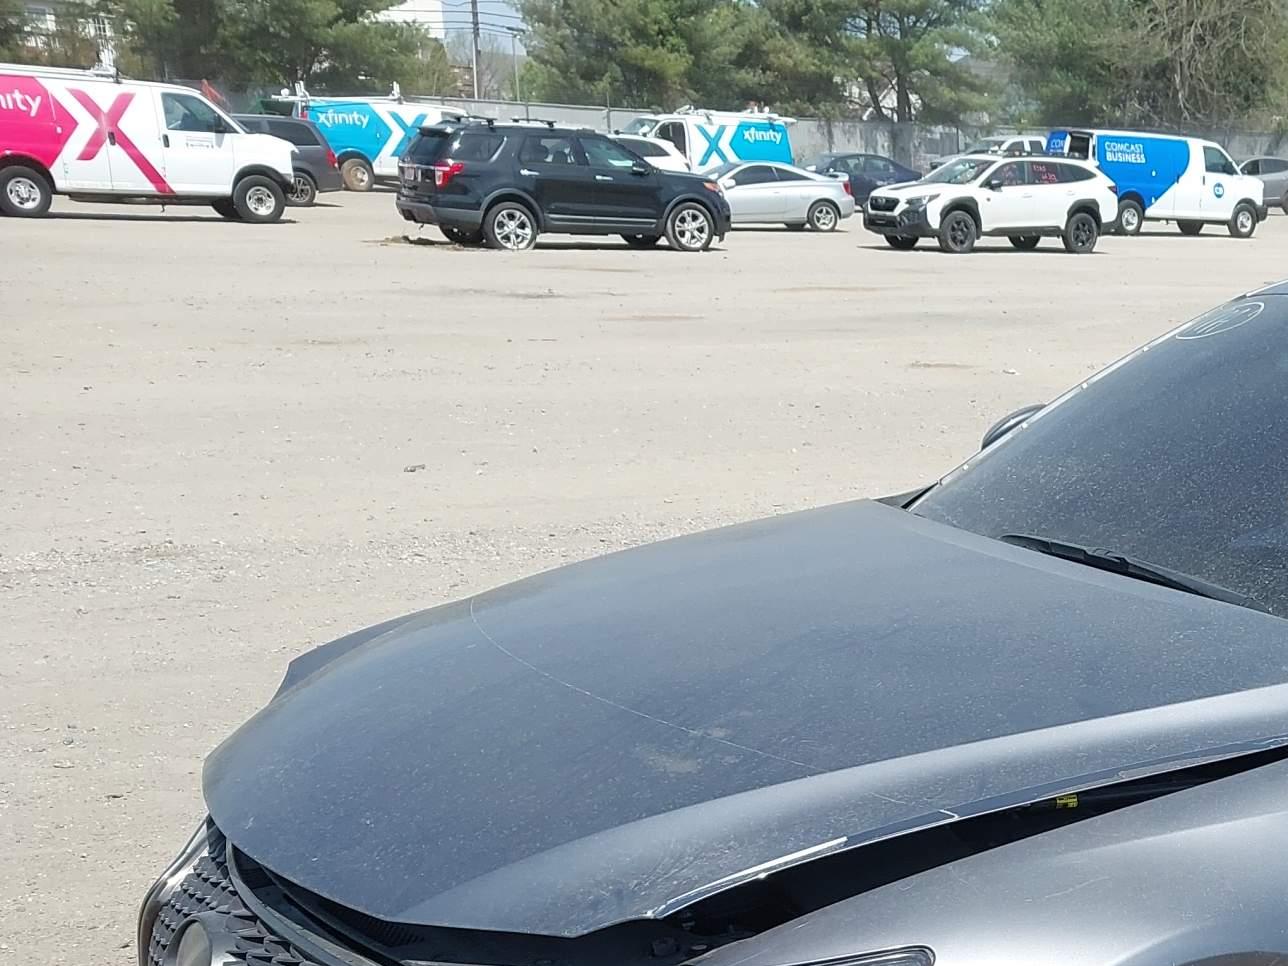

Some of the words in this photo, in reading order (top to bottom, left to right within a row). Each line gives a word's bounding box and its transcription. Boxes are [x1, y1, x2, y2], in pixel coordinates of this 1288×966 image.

[317, 109, 370, 129] xfinity
[743, 127, 782, 144] xfinity
[1104, 141, 1144, 153] COMCAST
[1106, 152, 1146, 163] BUSINESS
